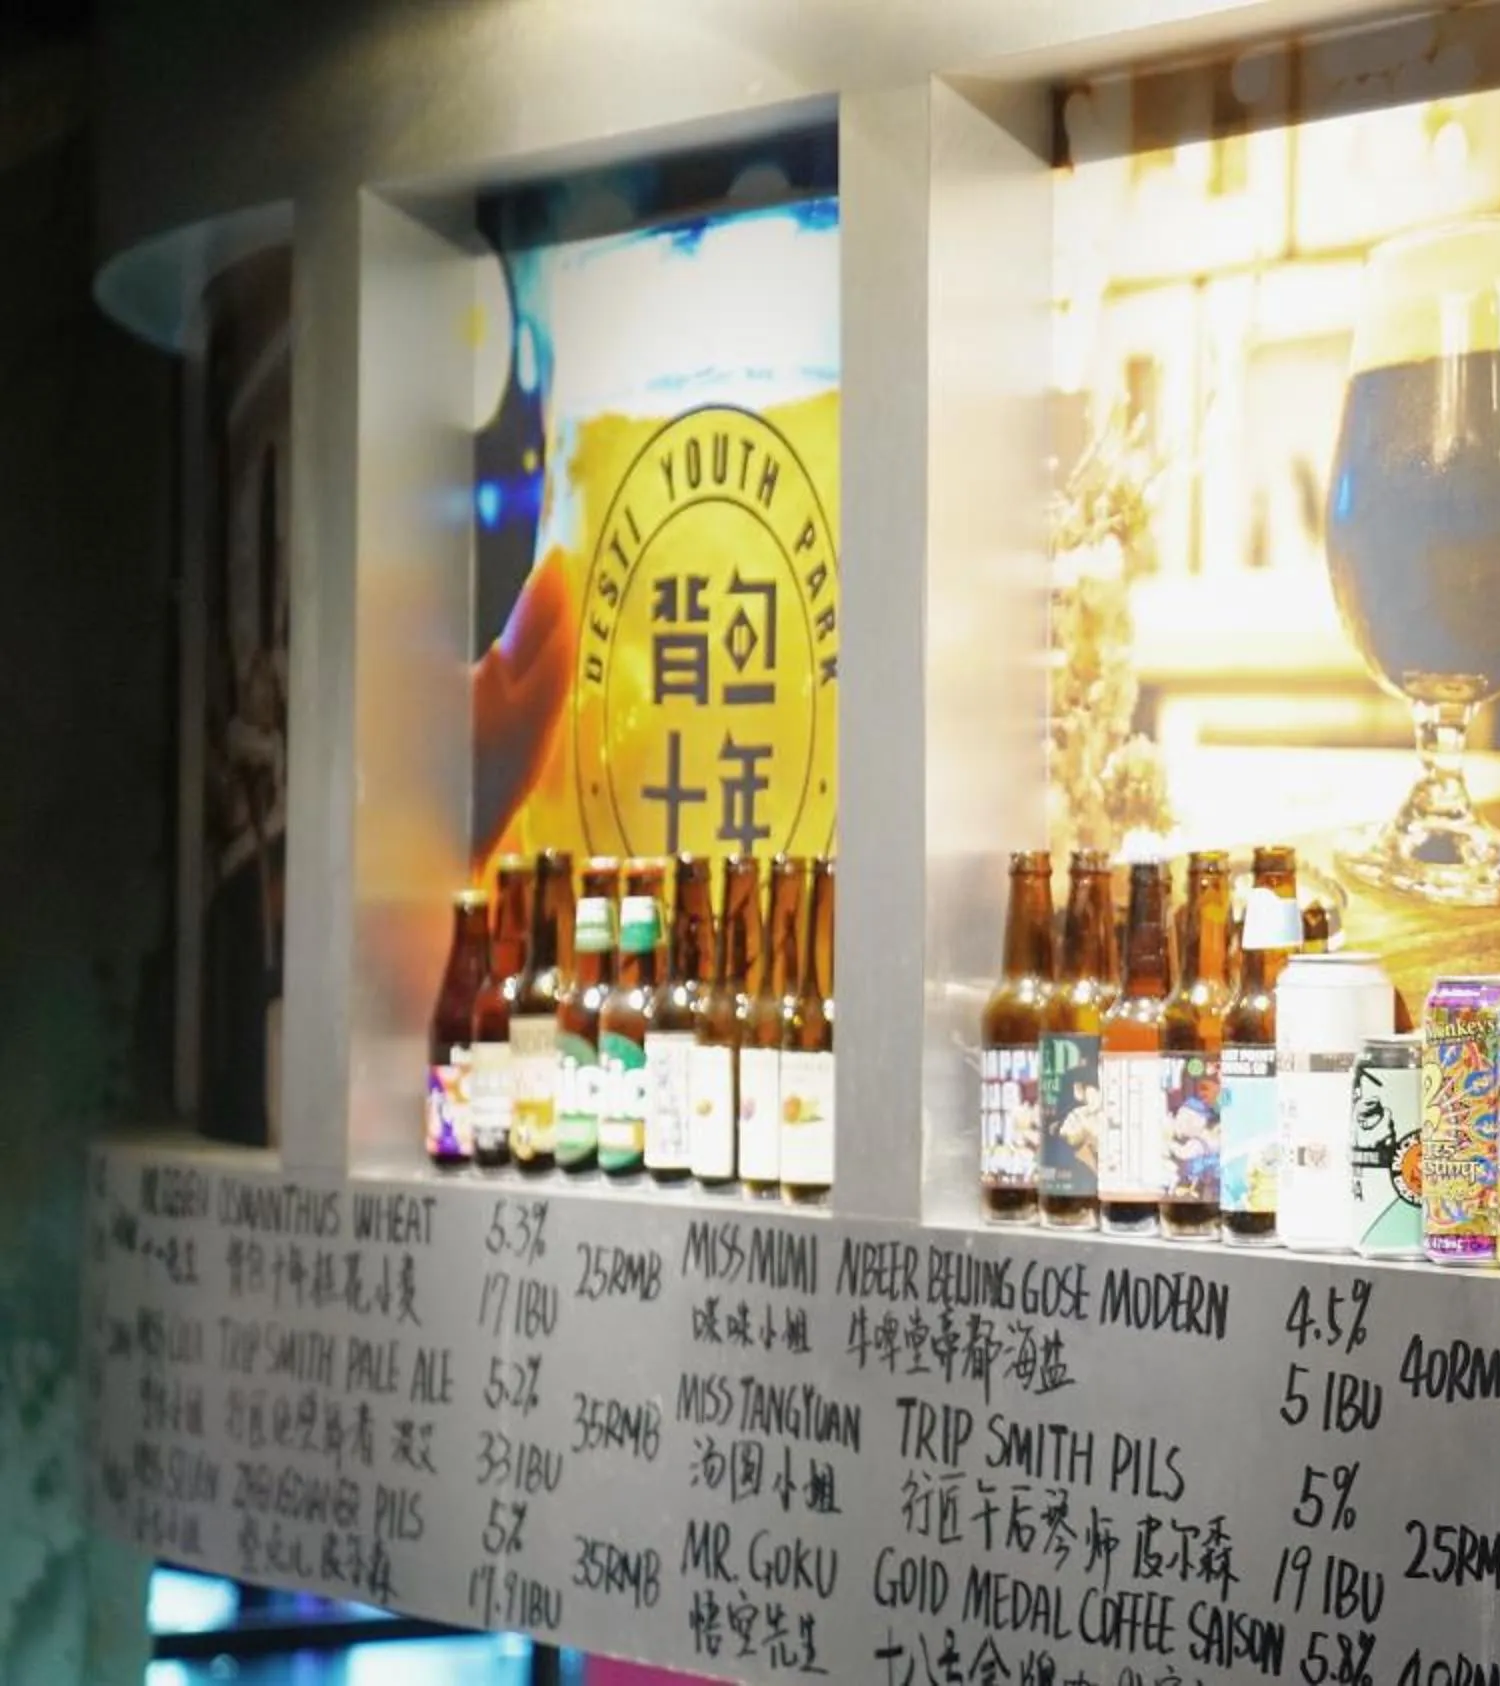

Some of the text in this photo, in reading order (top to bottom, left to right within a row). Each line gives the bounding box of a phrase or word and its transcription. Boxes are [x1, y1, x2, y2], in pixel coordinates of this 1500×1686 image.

[585, 506, 642, 684] DESTI
[660, 433, 780, 508] YOUTH
[641, 728, 775, 856] 十年
[352, 1192, 438, 1245] WHEAT
[486, 1201, 550, 1264] 5.3%
[681, 1221, 747, 1284] MISS
[574, 1241, 662, 1301] 25RMB
[1020, 1259, 1091, 1322] GOSE
[1100, 1267, 1231, 1341] MODERN
[1284, 1279, 1374, 1355] 4.5%
[410, 1346, 453, 1405] ALE
[483, 1354, 542, 1418] 5.2%
[676, 1372, 861, 1453] MISS TANGYUAN
[570, 1391, 662, 1464] 35RMB
[895, 1396, 1186, 1502] TRIP SMITH PILS
[373, 1480, 426, 1542] PILS
[481, 1499, 528, 1558] 5%
[1292, 1460, 1361, 1534] 5%
[572, 1533, 662, 1609] 35RMB
[681, 1518, 838, 1600] MR. GOKU
[689, 1588, 830, 1675] 悟空先生
[961, 1563, 1073, 1641] MEDAL
